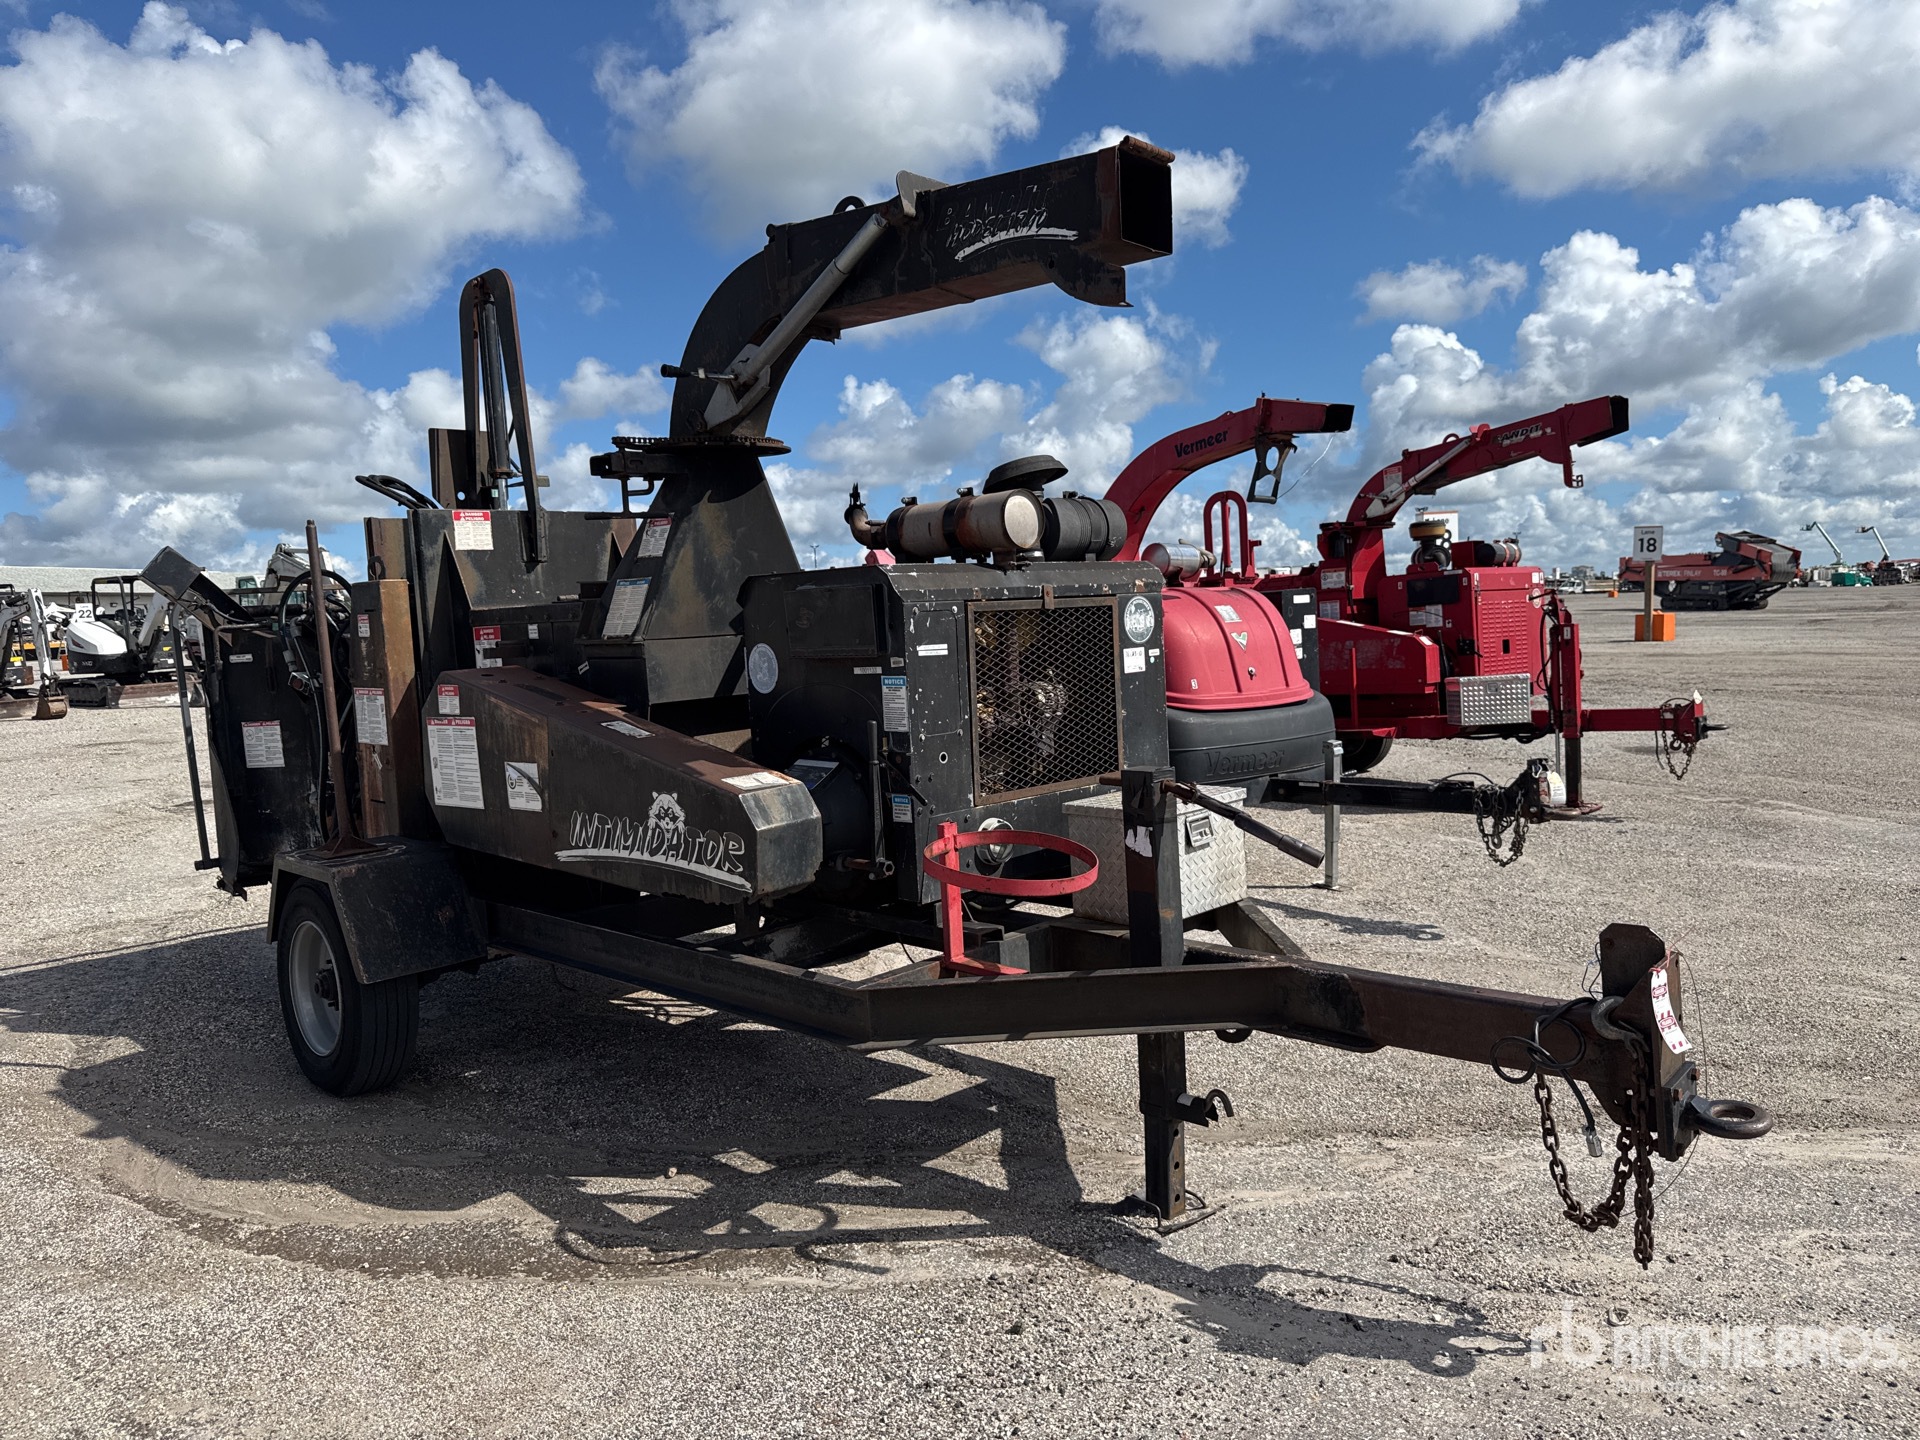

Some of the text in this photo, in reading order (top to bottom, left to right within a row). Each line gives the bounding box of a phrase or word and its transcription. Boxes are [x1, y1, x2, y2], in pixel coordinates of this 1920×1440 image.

[1174, 430, 1228, 458] Vermeer
[1494, 423, 1542, 443] ANDIT
[1638, 537, 1657, 552] 18
[78, 609, 92, 618] 22
[1204, 749, 1285, 777] Vermeer
[569, 810, 745, 873] INTIMIDATOR
